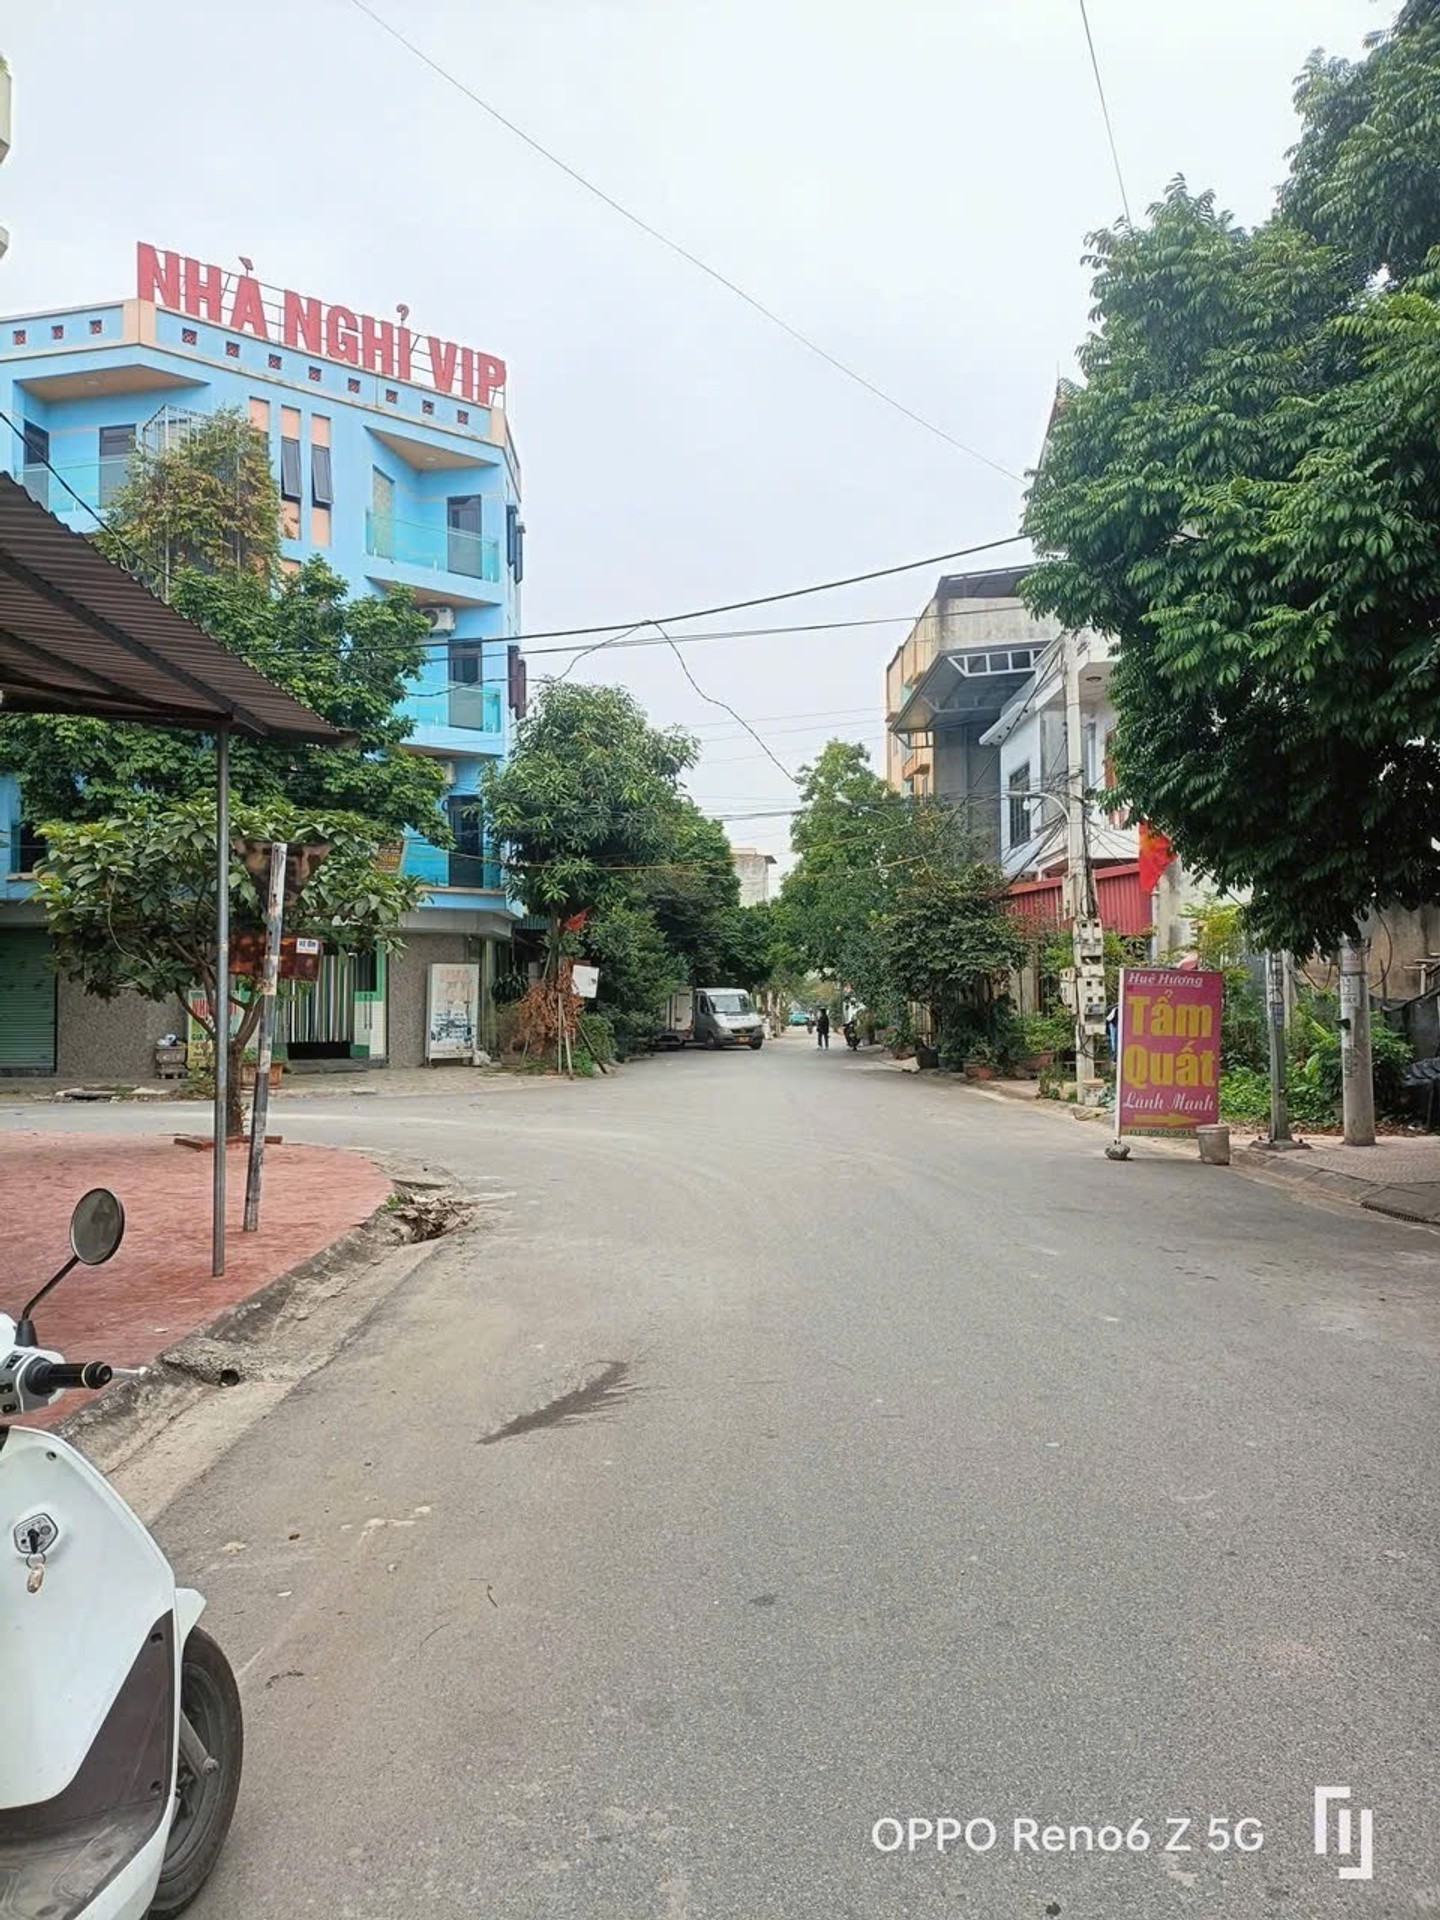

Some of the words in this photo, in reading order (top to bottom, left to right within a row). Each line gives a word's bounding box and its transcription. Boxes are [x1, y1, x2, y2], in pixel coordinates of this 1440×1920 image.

[137, 241, 269, 341] NHÀ
[284, 290, 412, 381] NGHỈ
[428, 336, 507, 406] VIP
[1158, 973, 1203, 988] Hương
[1127, 990, 1214, 1038] Tẩm
[1123, 1041, 1216, 1089] Quất
[1167, 1092, 1215, 1114] Mạnh
